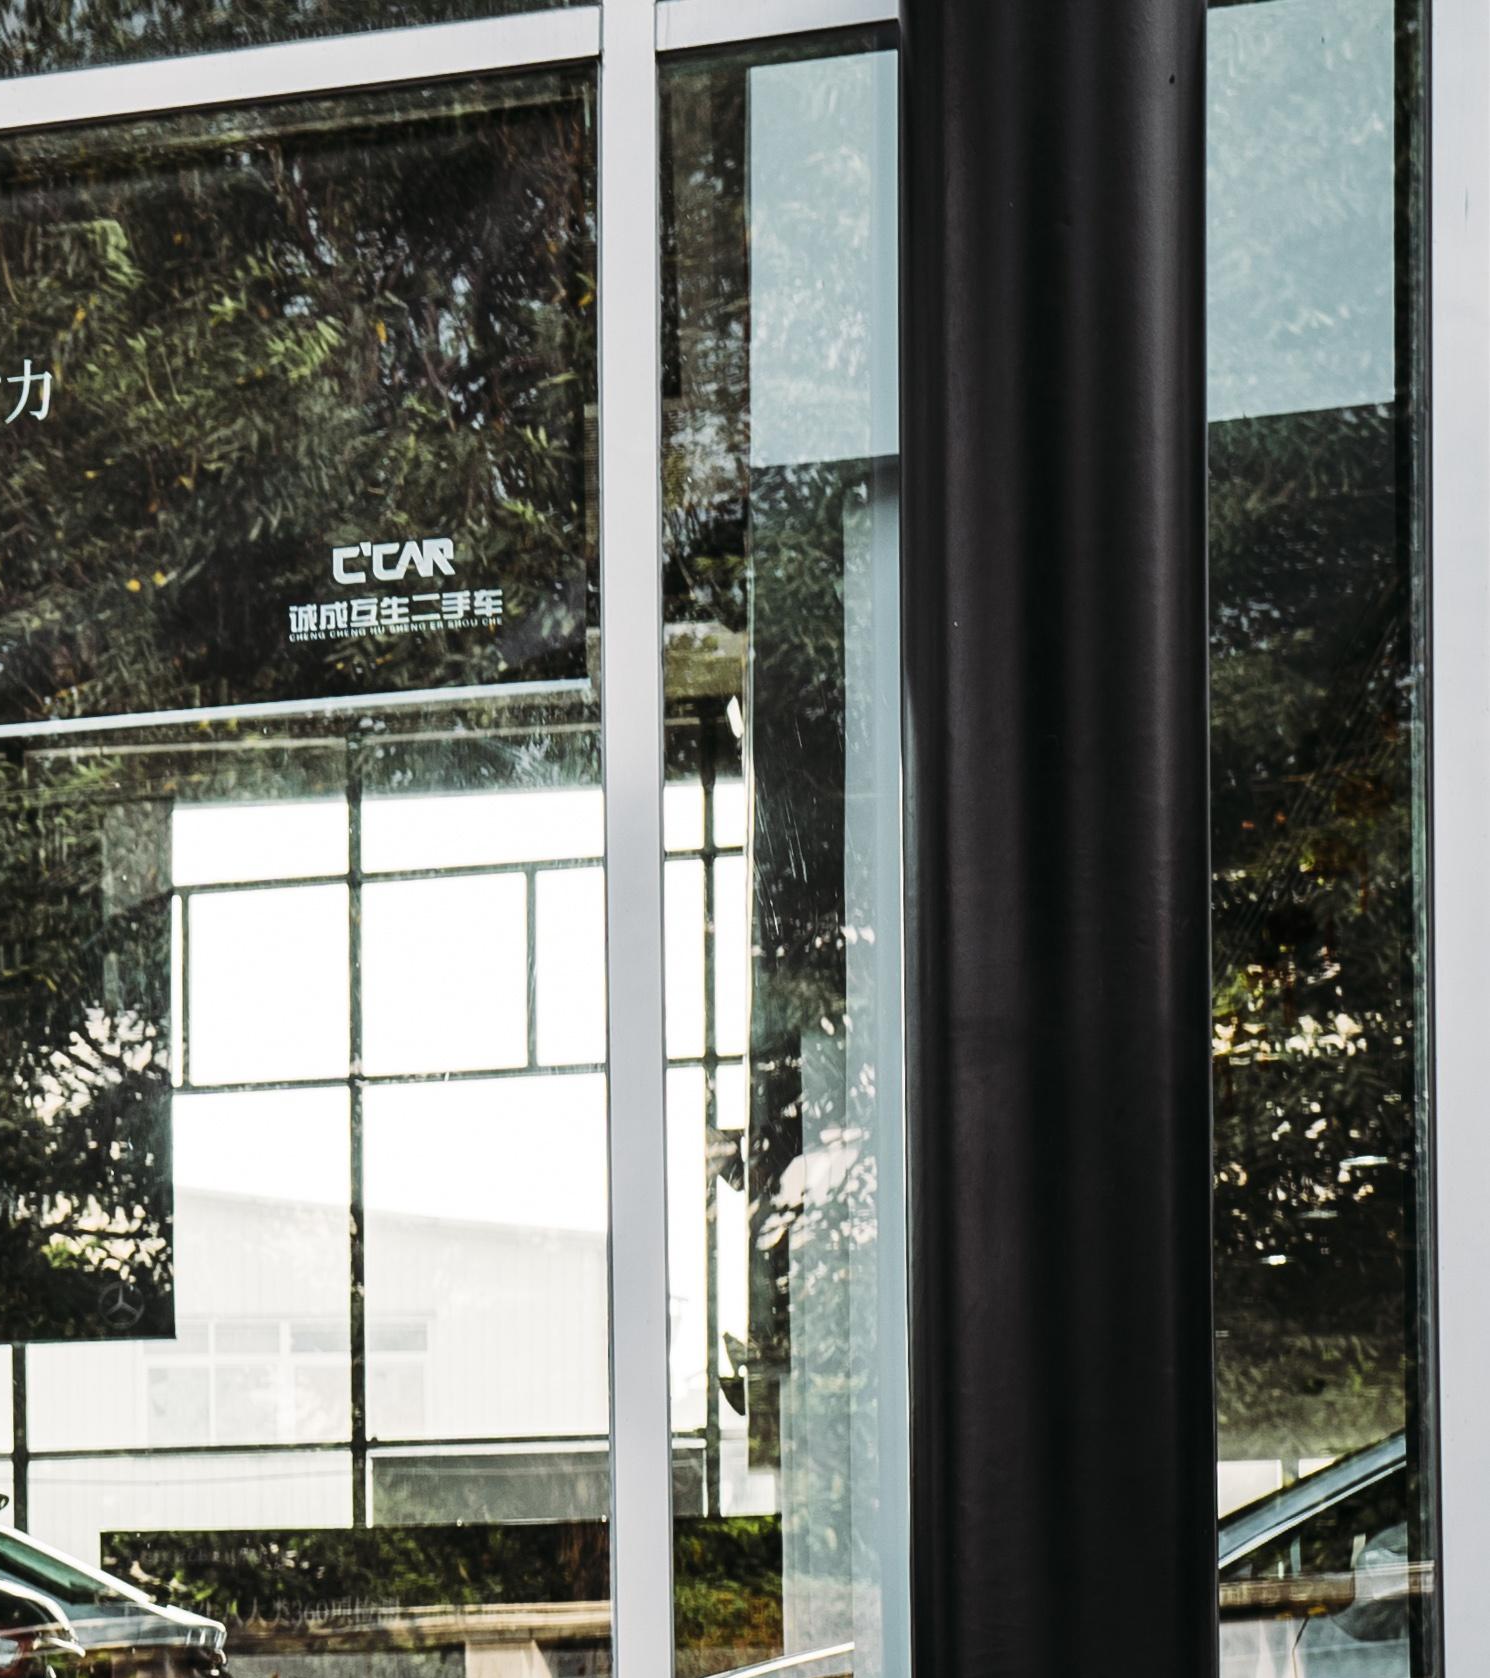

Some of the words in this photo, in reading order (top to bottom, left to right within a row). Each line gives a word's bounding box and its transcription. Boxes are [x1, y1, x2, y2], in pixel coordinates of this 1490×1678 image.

[289, 588, 503, 634] 诚成互生二手车
